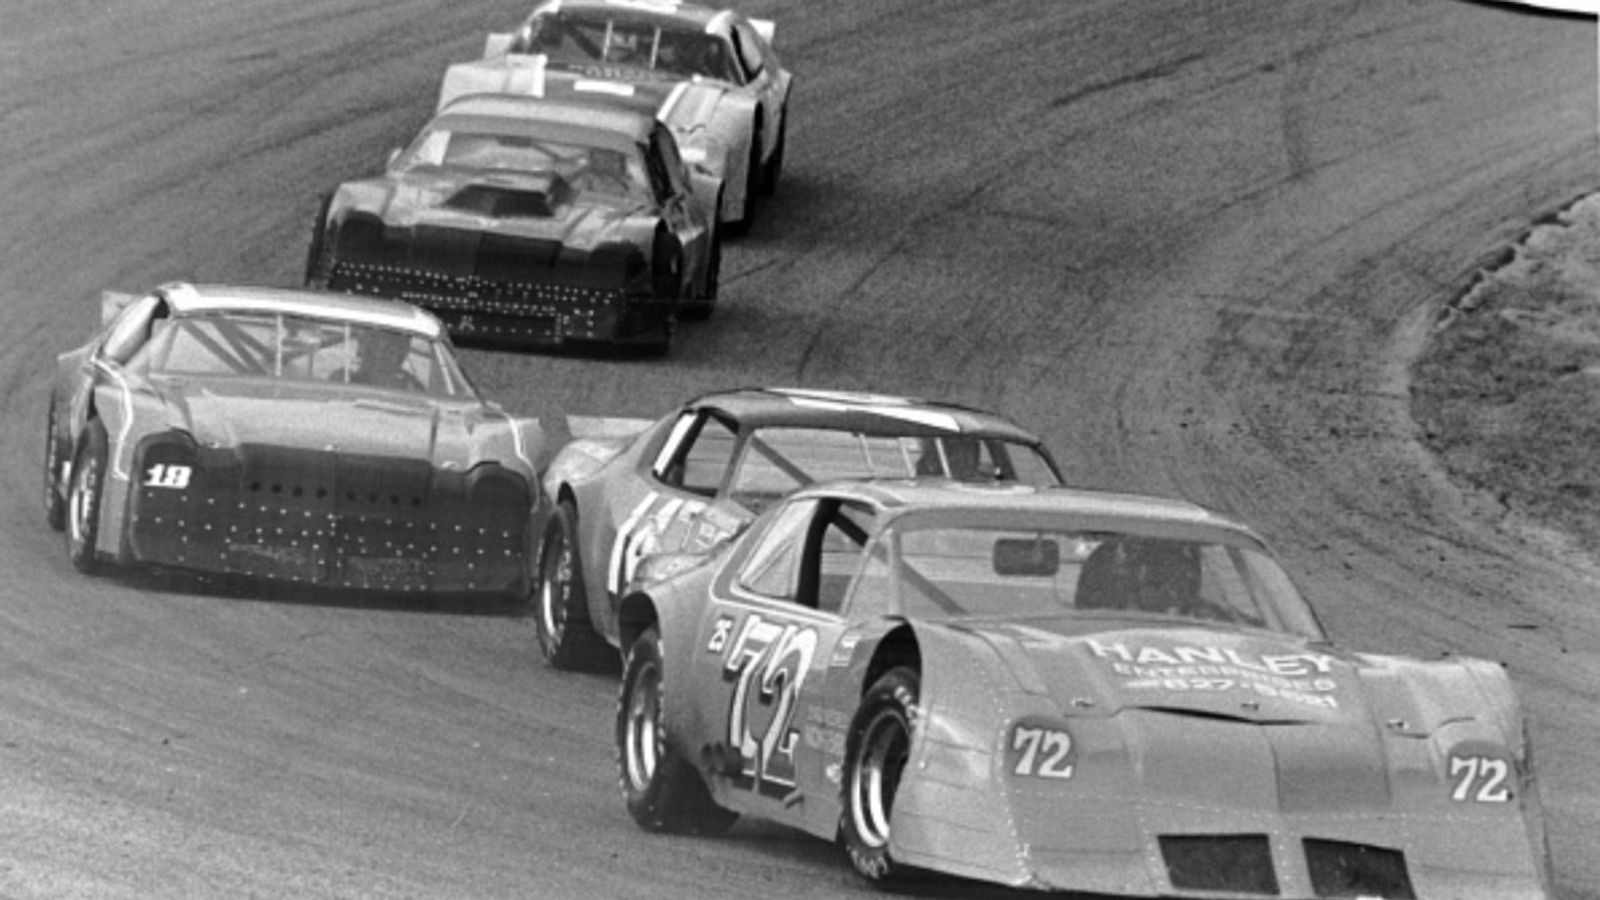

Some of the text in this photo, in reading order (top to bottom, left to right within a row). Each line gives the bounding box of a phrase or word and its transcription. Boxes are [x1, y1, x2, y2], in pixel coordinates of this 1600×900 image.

[143, 463, 192, 489] 18
[1085, 638, 1333, 675] HANLEY
[726, 613, 818, 787] 72
[1014, 727, 1073, 779] 72
[1451, 756, 1507, 802] 72
